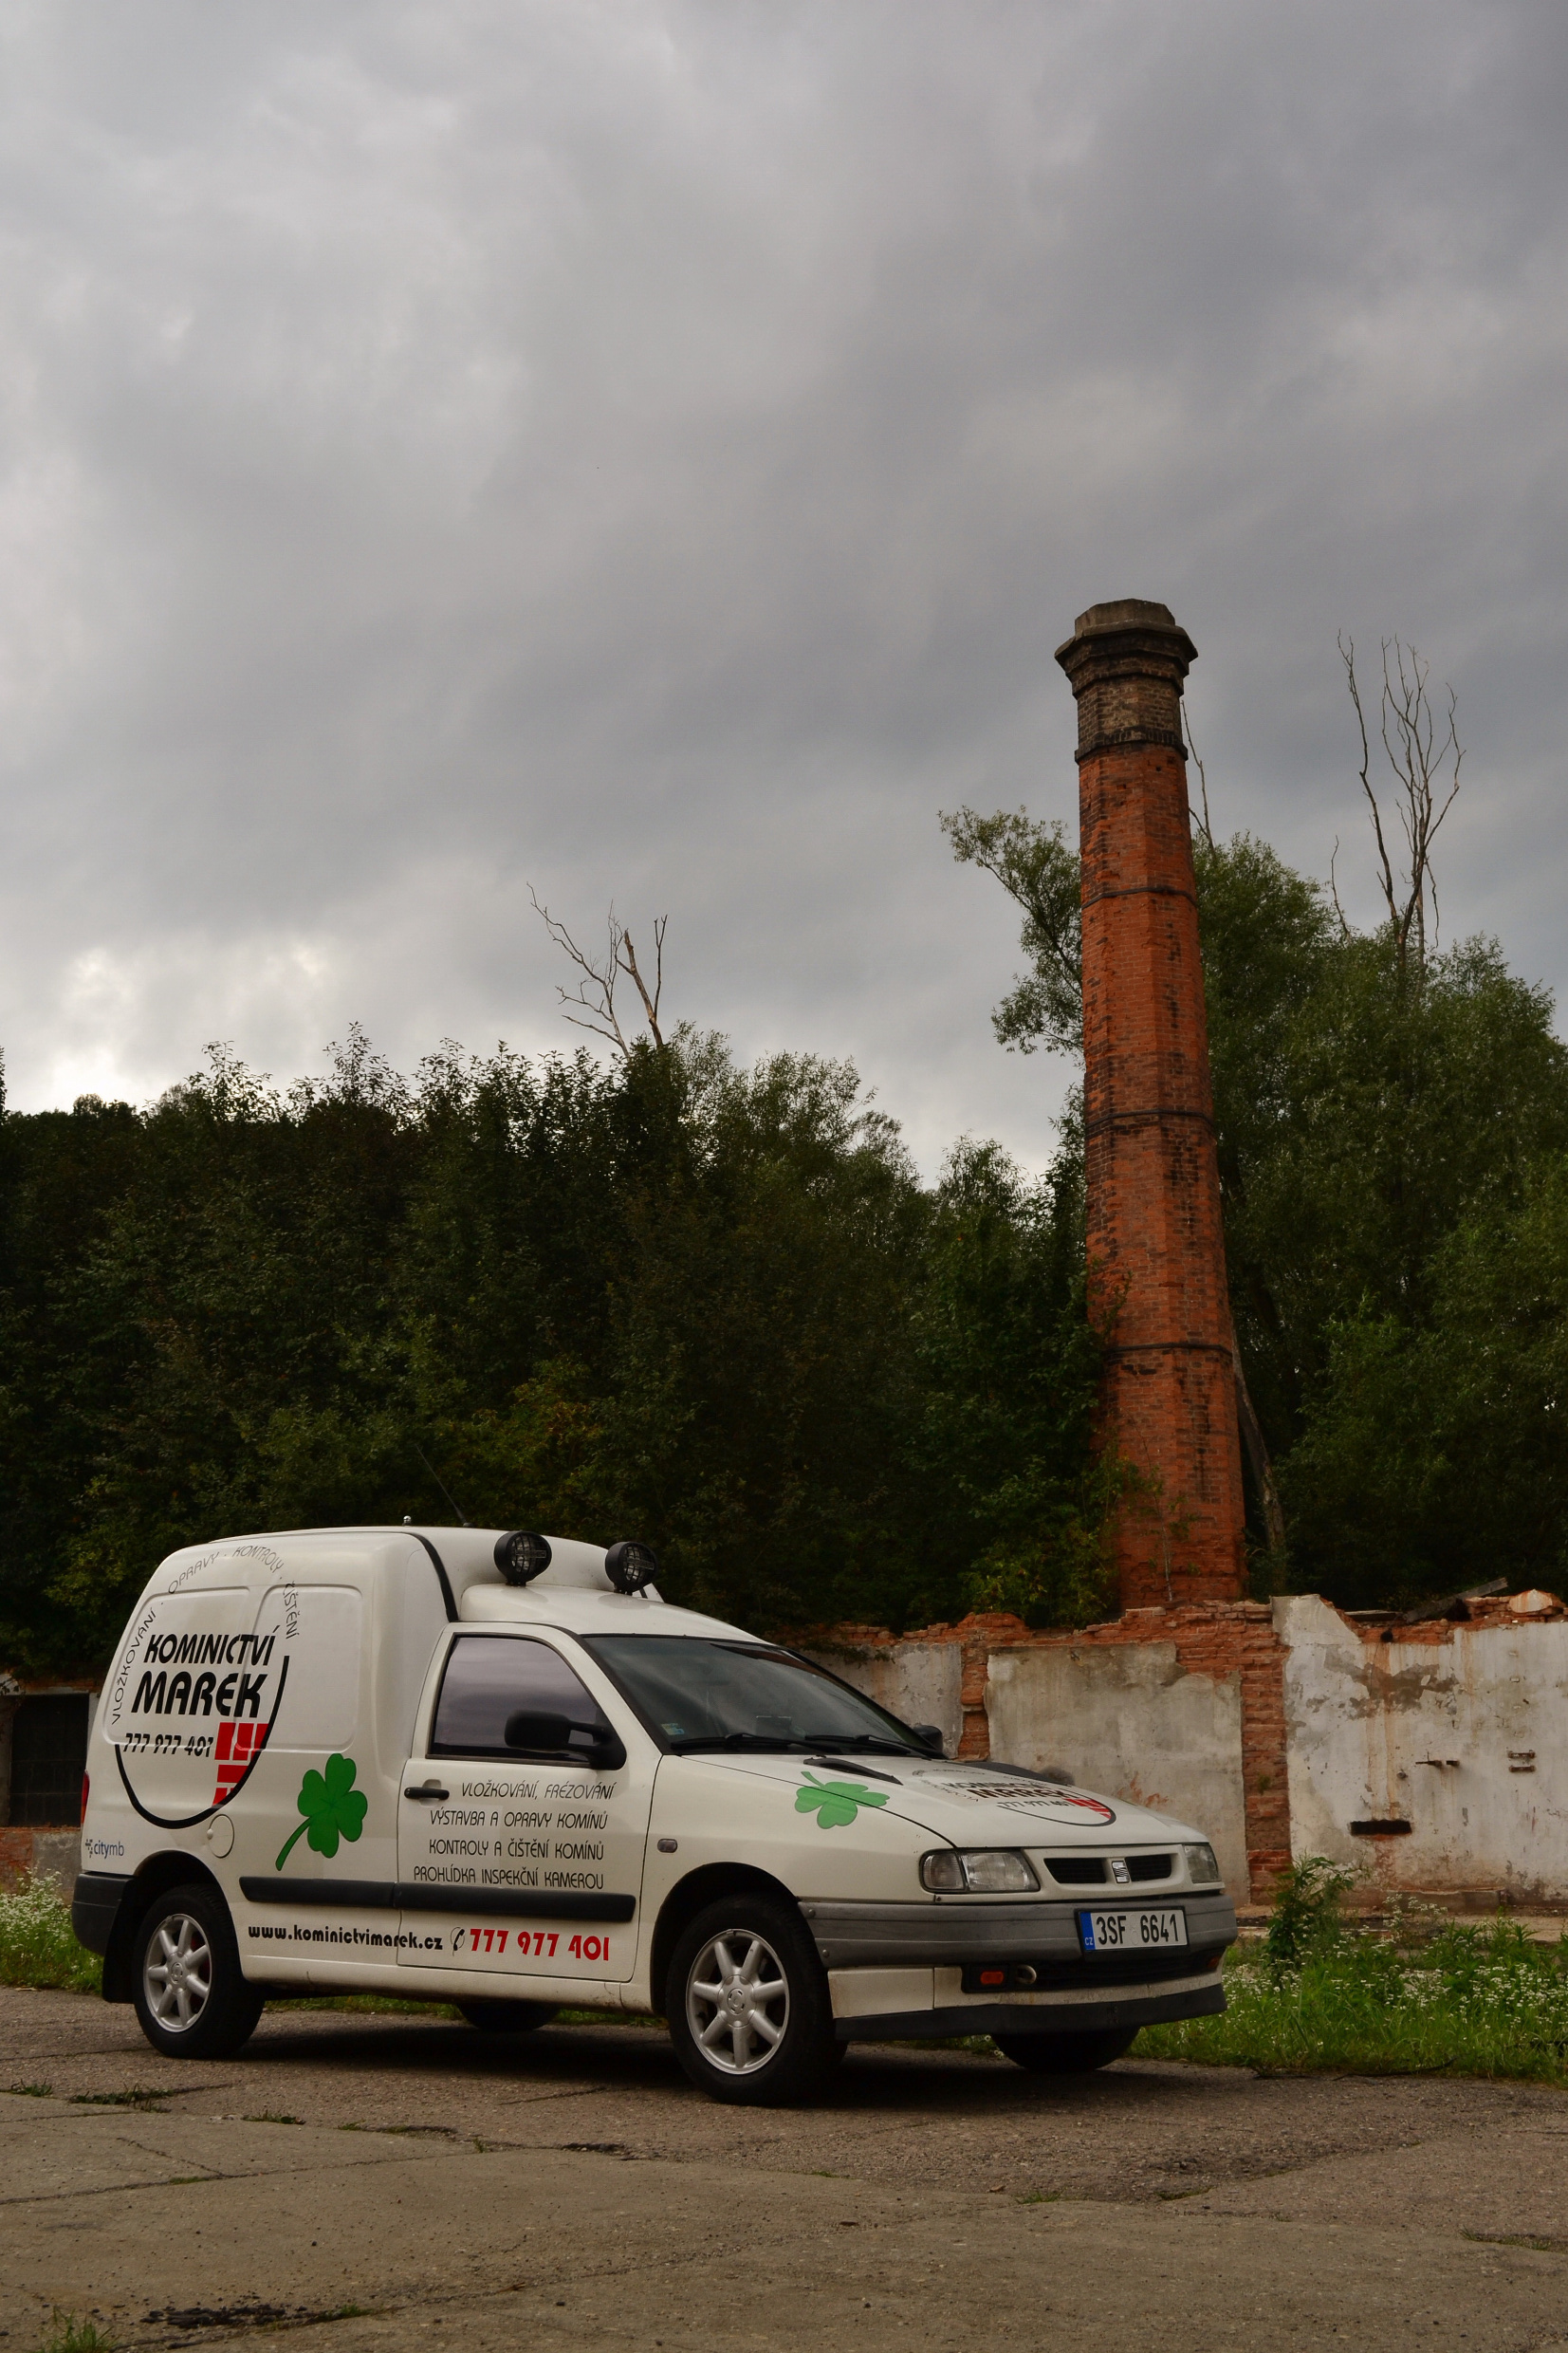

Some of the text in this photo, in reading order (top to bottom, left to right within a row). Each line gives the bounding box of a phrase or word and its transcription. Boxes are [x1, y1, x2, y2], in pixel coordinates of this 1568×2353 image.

[168, 1546, 284, 1595] OPRAVY KONTROLY
[143, 1625, 281, 1666] KOMINICTVÍ
[111, 1607, 157, 1725] VLOŽKOVÁNÍ
[131, 1671, 267, 1718] MAREK
[124, 1733, 213, 1757] 777 977 401
[462, 1779, 618, 1800] VLOŽKOVÁNÍ, FRÉZOVÁNÍ
[430, 1806, 608, 1830] VÝSTAVBA A OPRAVY KOMÍNŮ
[94, 1840, 124, 1859] citymb
[429, 1838, 604, 1861] KONTROLY A ČIŠTĚNÍ KOMÍNŮ
[414, 1863, 604, 1890] PROHLÍDKA INSPEKČNÍ KAMEROU
[248, 1924, 443, 1951] www.kominictvimarek.cz
[1084, 1936, 1094, 1946] CZ
[1096, 1913, 1179, 1945] 3SF 6641
[470, 1928, 609, 1961] 777 977 401
